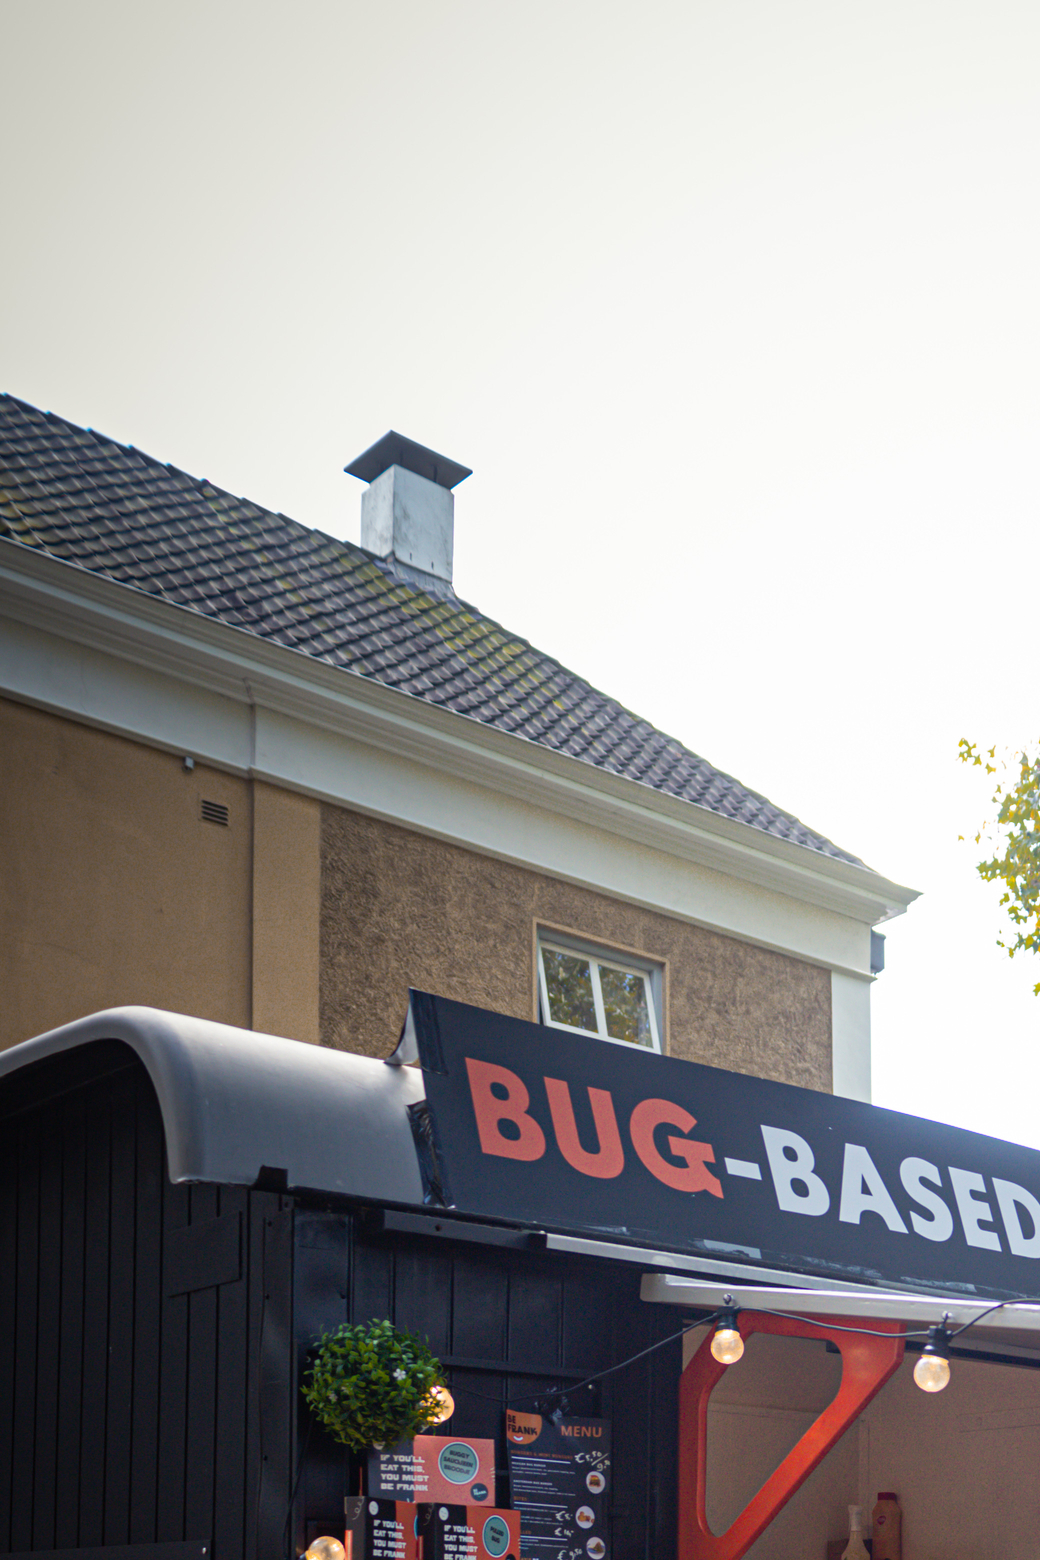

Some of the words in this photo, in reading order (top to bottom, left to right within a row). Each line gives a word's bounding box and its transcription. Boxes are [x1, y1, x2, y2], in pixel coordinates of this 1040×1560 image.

[508, 1424, 537, 1435] FRANK
[561, 1426, 602, 1437] MENU
[393, 1455, 425, 1463] YOU'LL
[383, 1521, 404, 1529] YOU'LL
[388, 1541, 406, 1549] MUST
